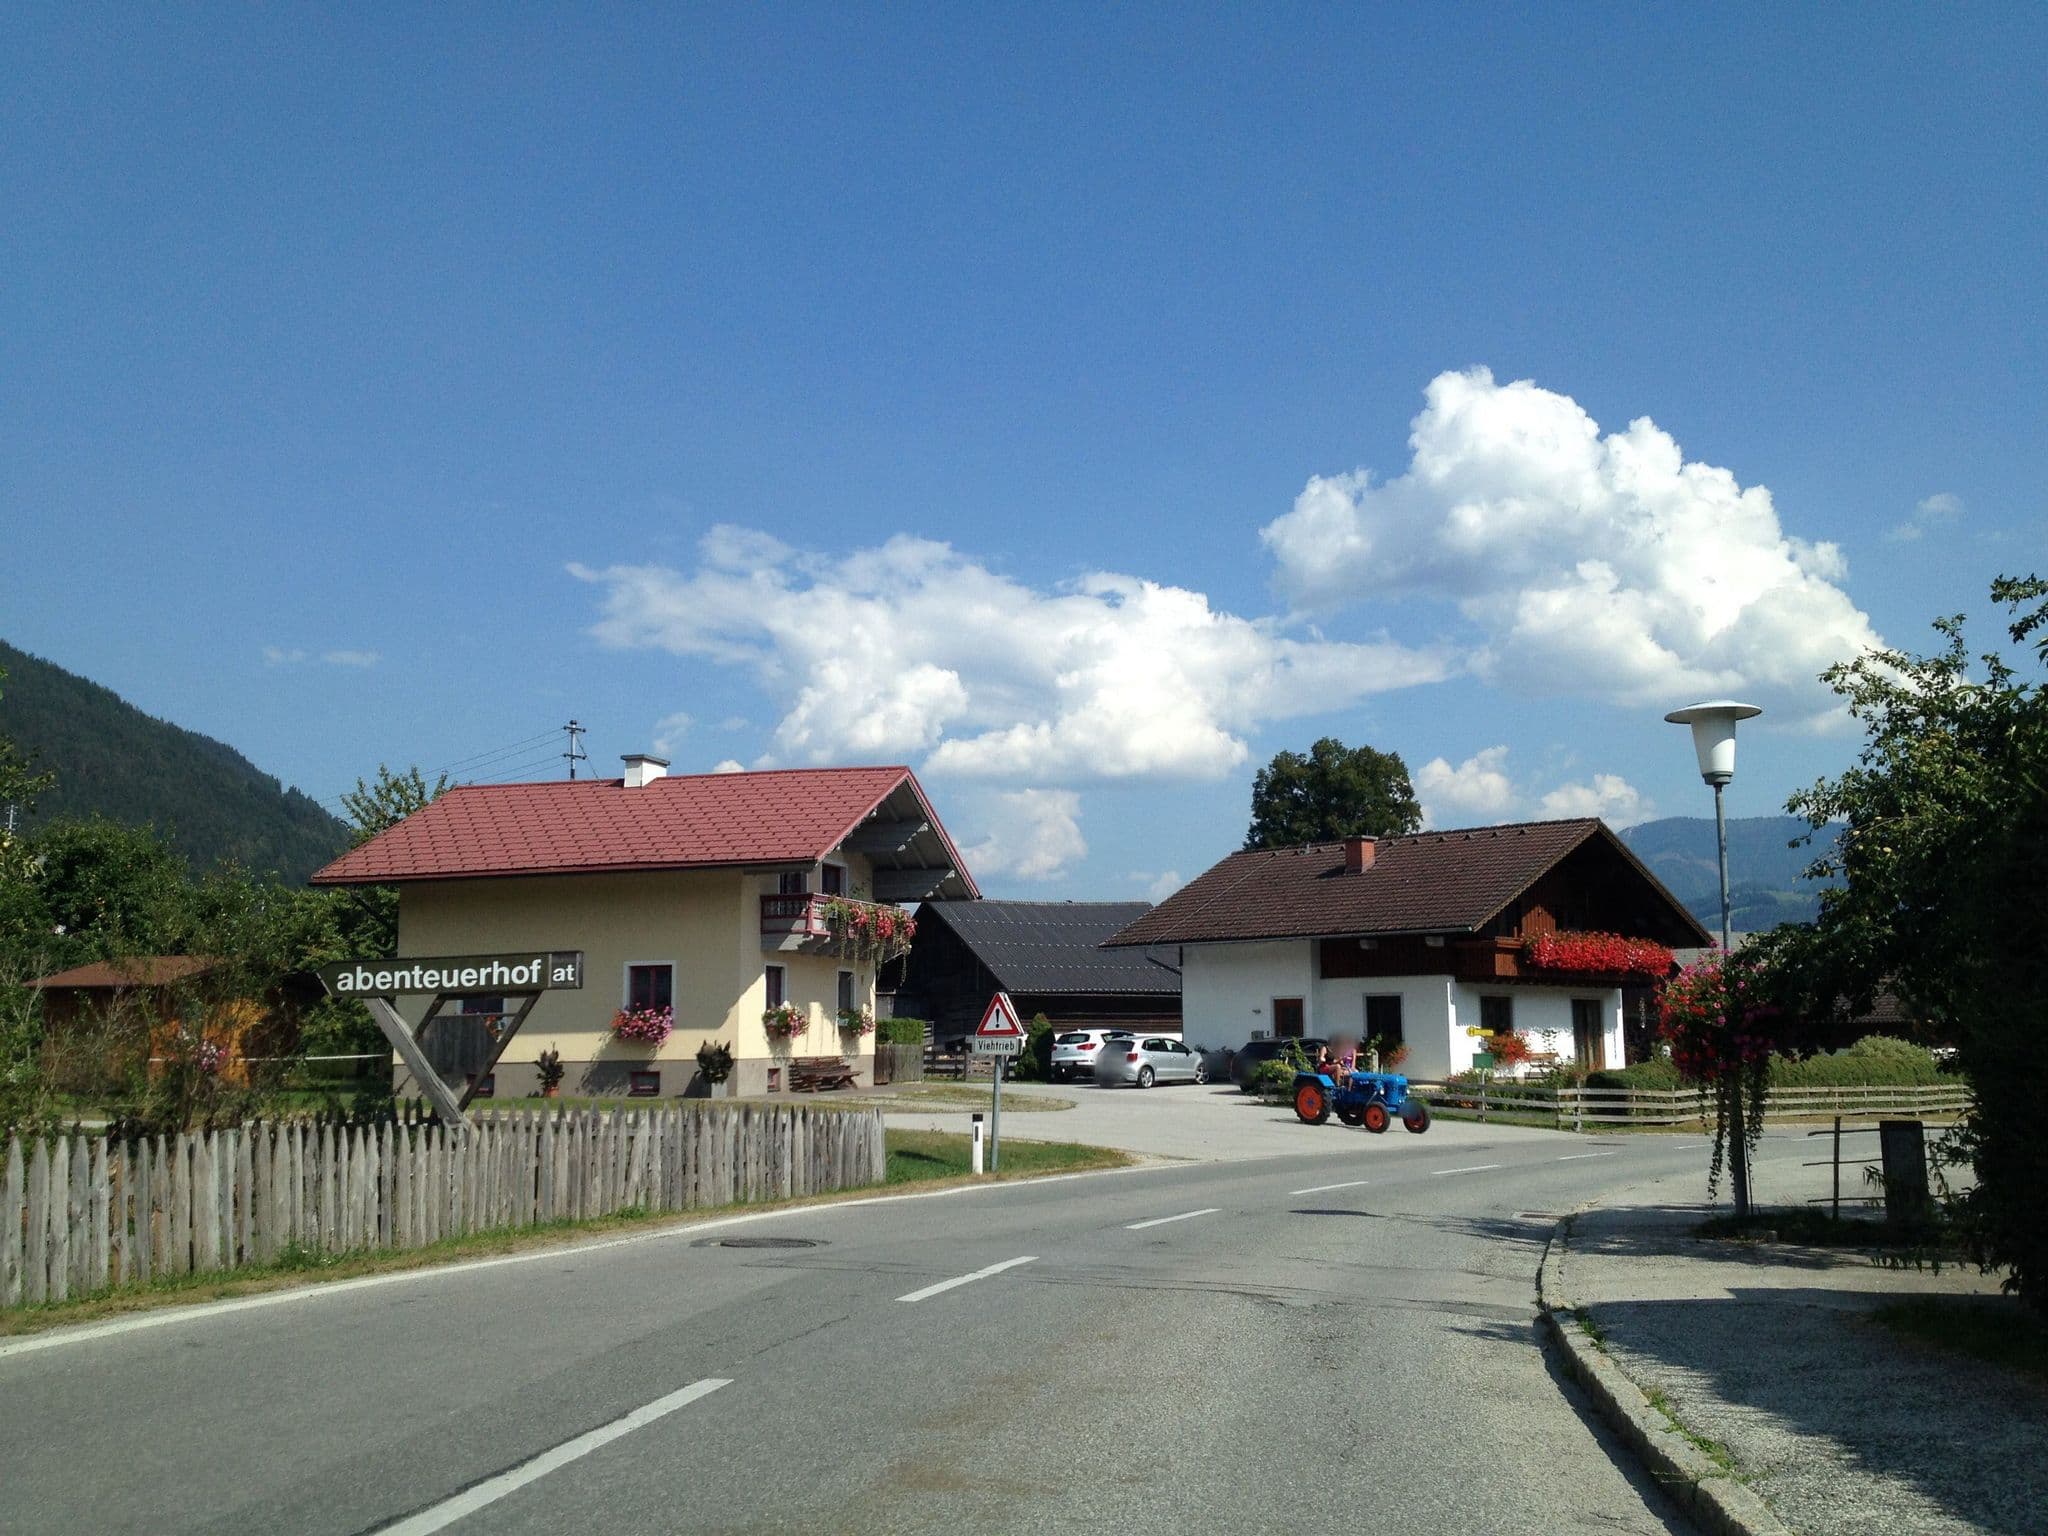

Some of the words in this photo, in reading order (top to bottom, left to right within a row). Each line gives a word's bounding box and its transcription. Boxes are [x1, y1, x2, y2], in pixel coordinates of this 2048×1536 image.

[337, 959, 541, 991] abenteuerhof
[552, 964, 575, 982] at
[978, 1040, 1015, 1050] Viehtrieb
